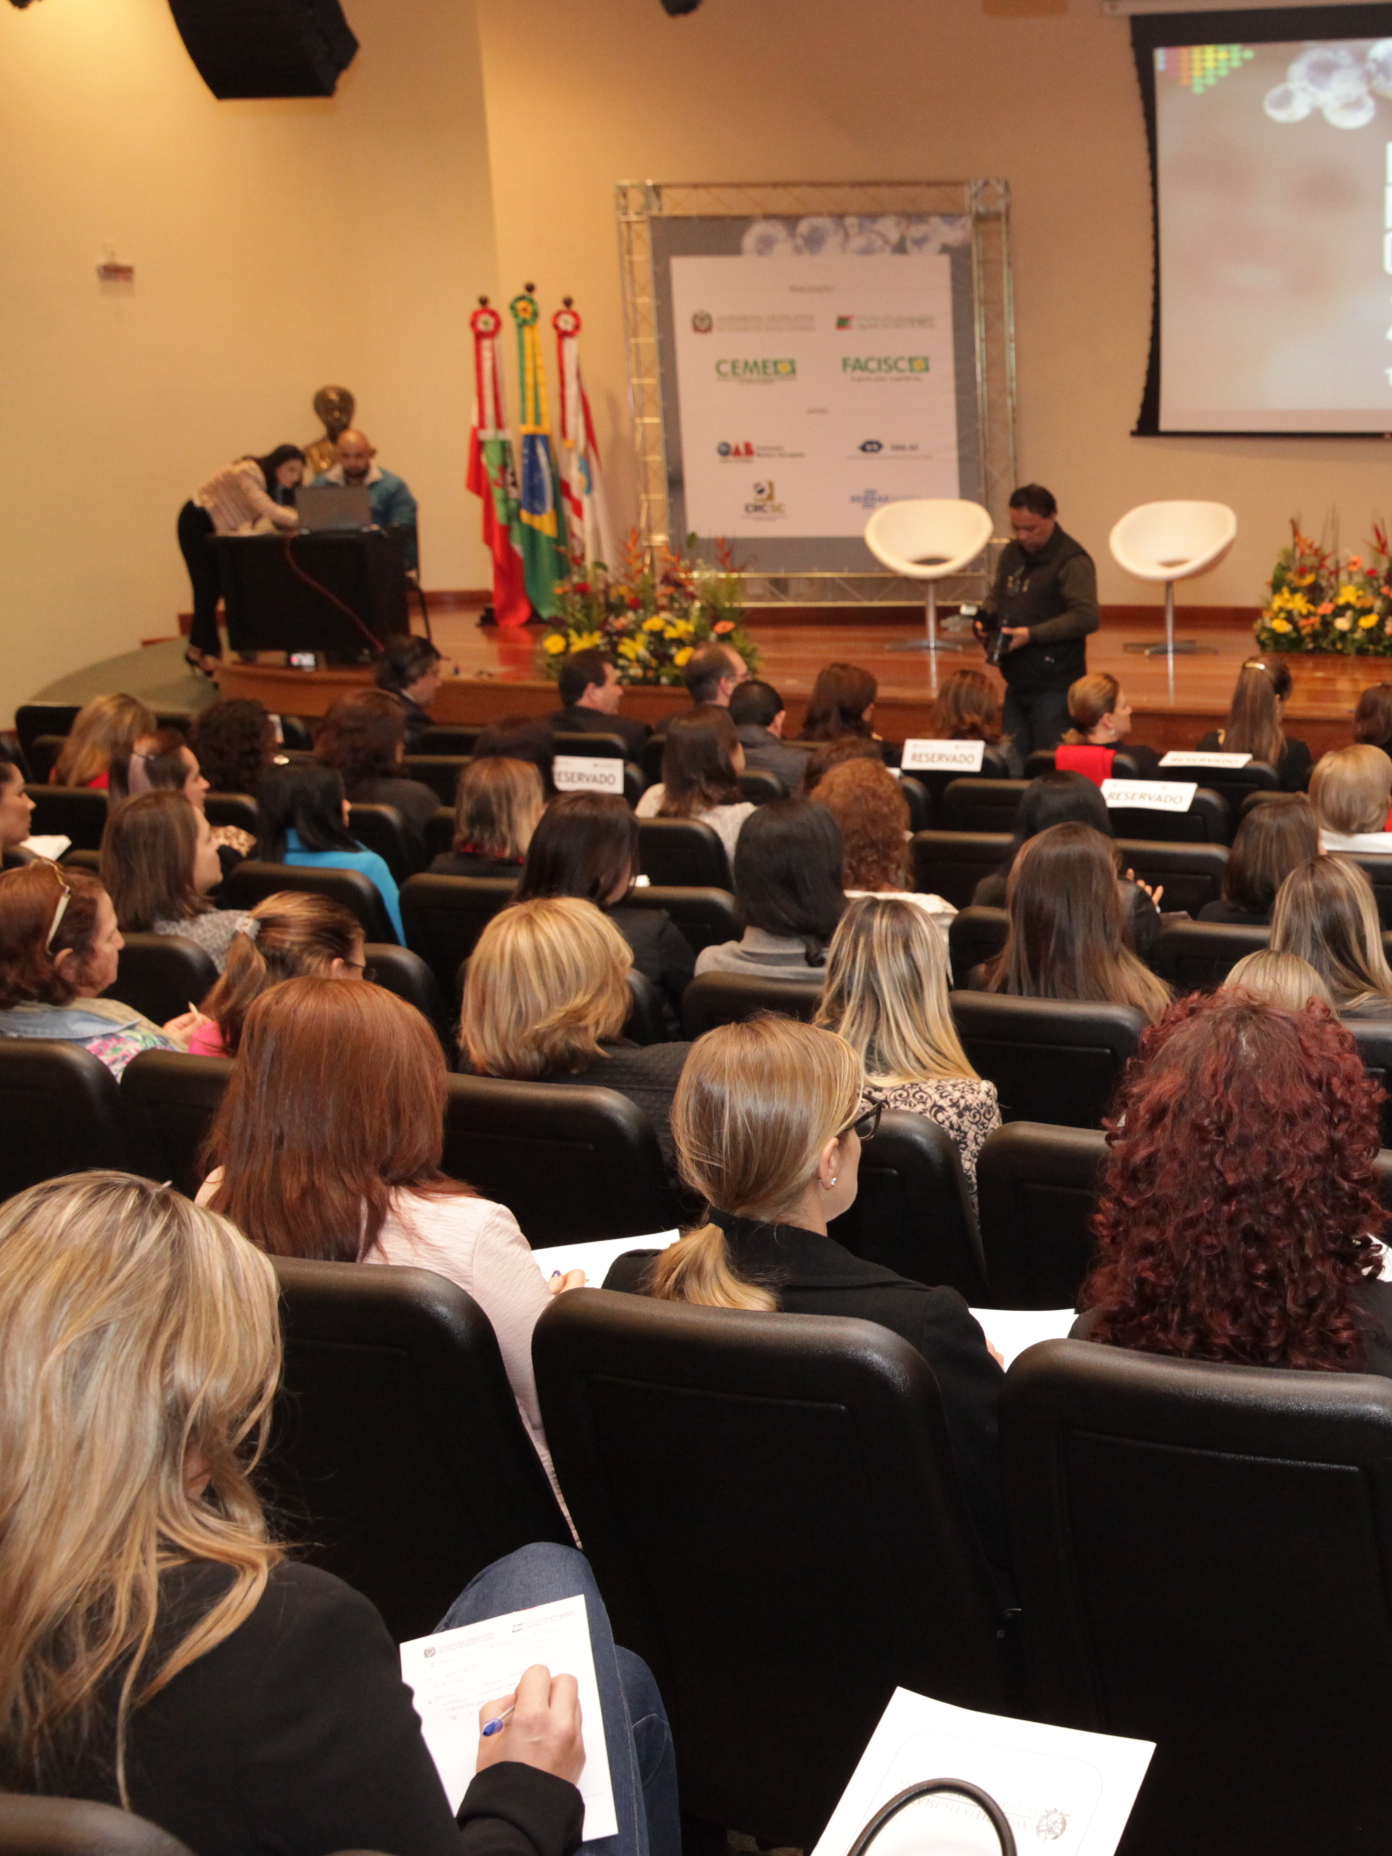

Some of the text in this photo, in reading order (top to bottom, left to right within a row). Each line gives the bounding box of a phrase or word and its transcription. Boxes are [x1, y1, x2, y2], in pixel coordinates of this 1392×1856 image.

[843, 357, 907, 373] FACISC
[910, 752, 976, 765] RESERVADO
[1107, 792, 1183, 804] RESERVADO
